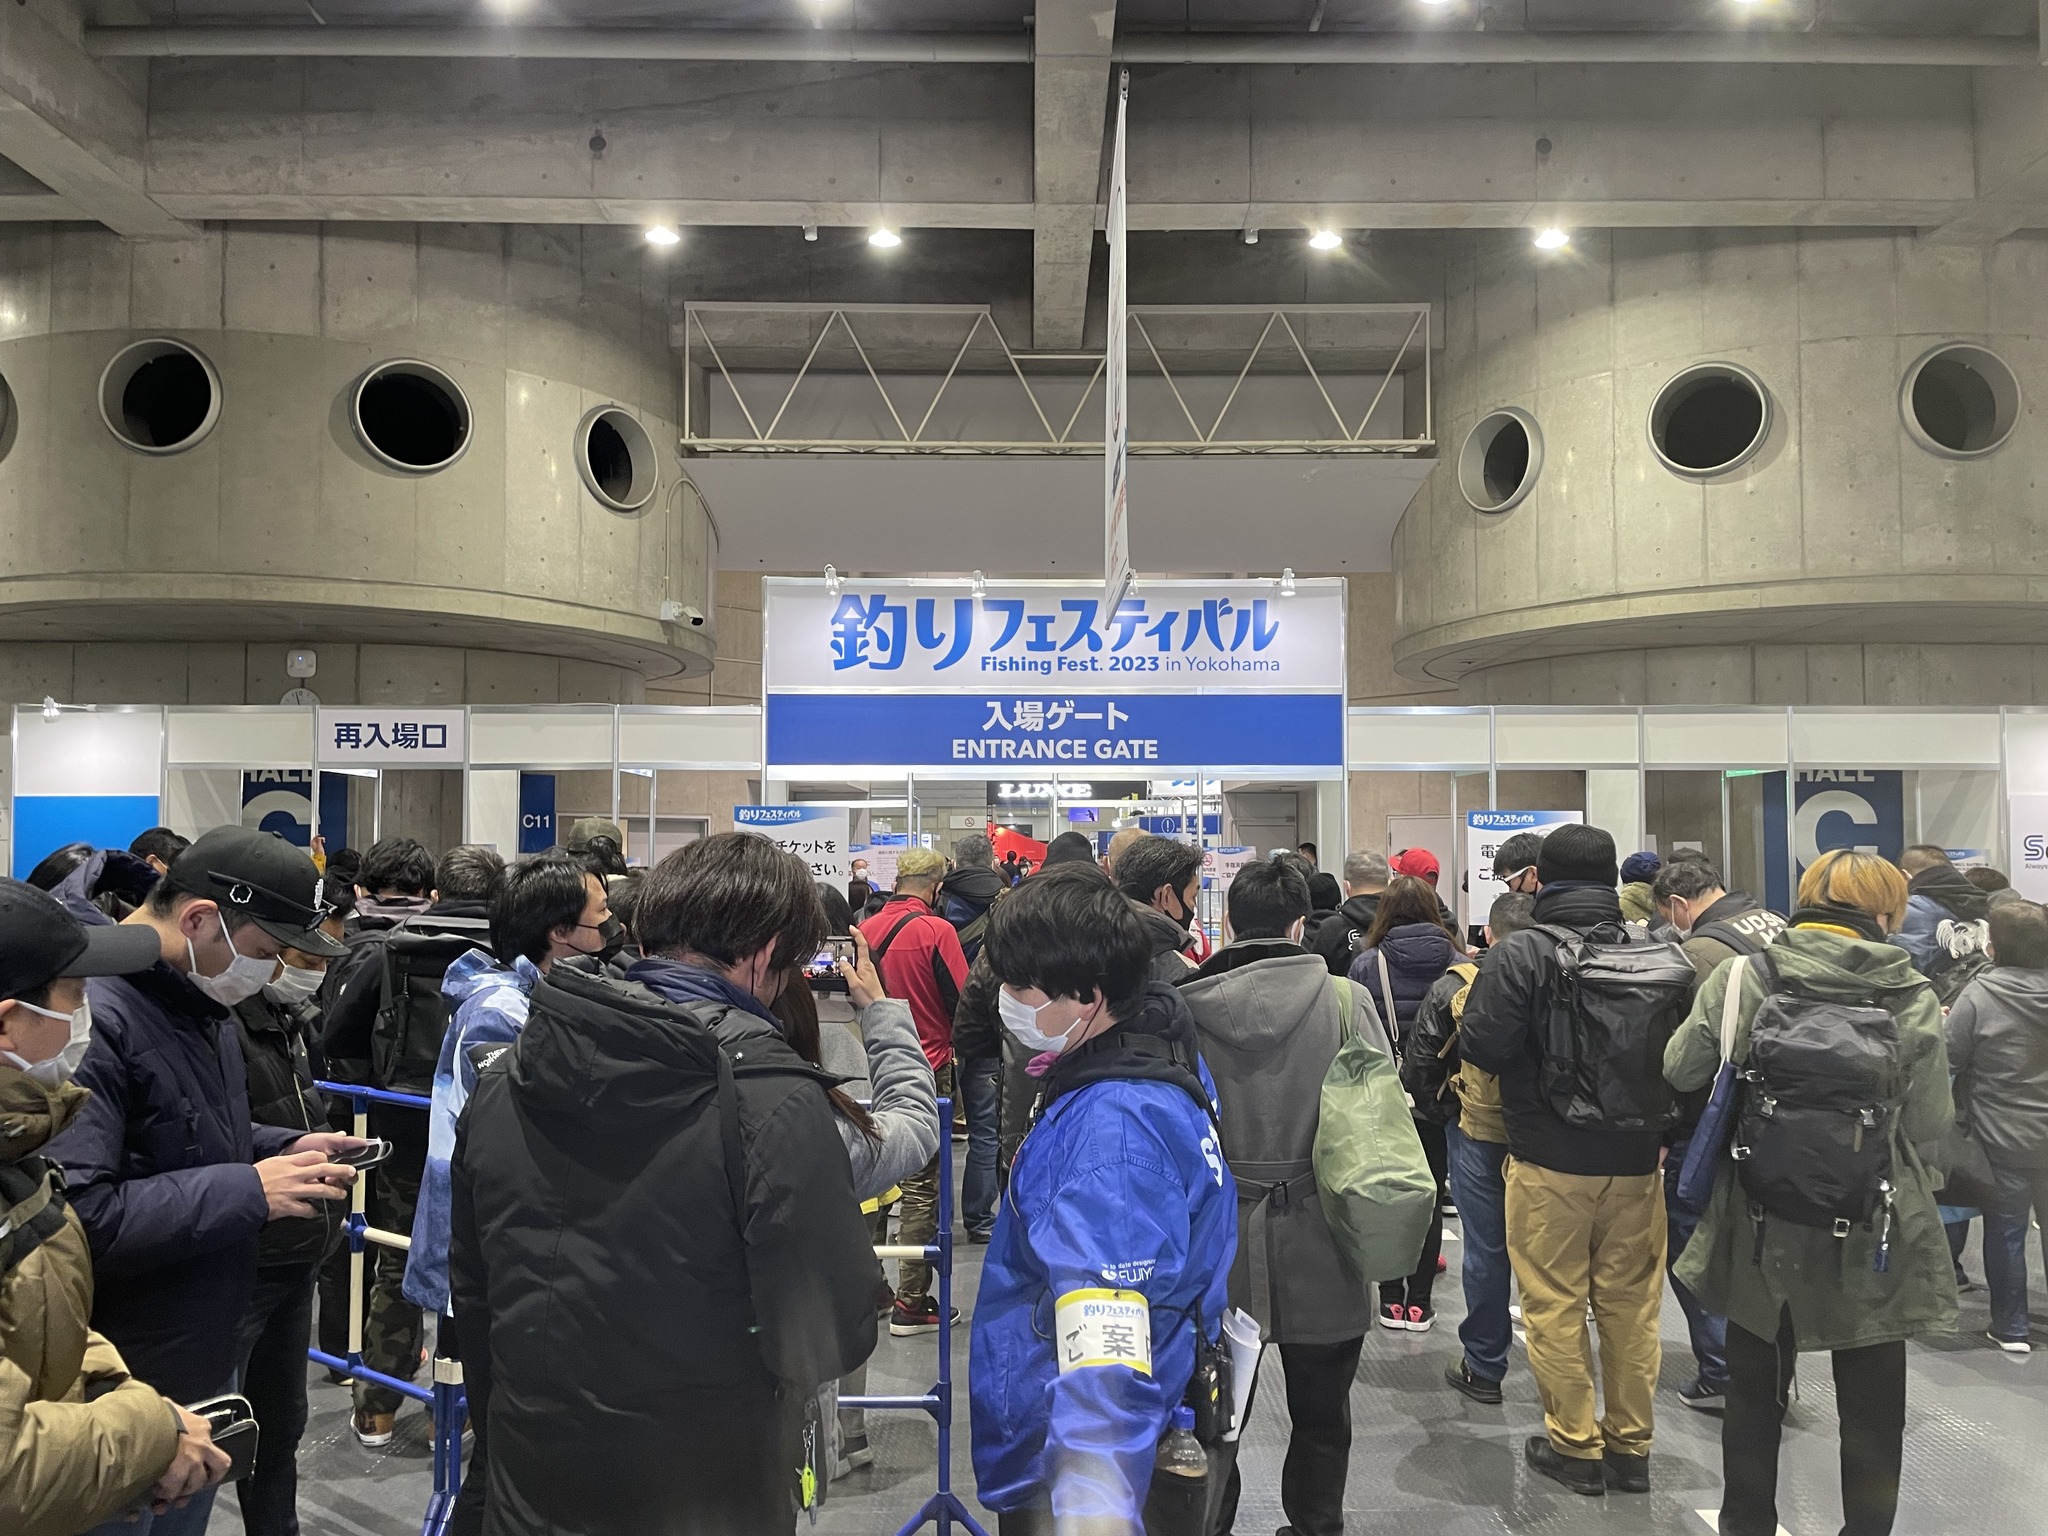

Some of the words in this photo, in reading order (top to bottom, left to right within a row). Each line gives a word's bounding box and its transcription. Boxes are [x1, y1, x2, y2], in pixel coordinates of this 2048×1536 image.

[831, 594, 1280, 672] 釣りフェスティバル
[981, 656, 1052, 675] Fishing
[1057, 656, 1103, 671] Fest.
[1108, 656, 1160, 671] 2023
[1166, 656, 1181, 671] in
[1185, 656, 1280, 671] Yokohama
[982, 700, 1130, 732] 入場ゲート
[334, 723, 447, 748] 再入場口
[952, 739, 1087, 759] ENTRANCE
[1094, 739, 1158, 759] GATE
[523, 814, 550, 829] C11
[739, 809, 801, 821] 釣りフェスティバル
[1472, 813, 1535, 826] 釣りフェスティバル
[1481, 844, 1502, 859] 電
[2023, 834, 2048, 861] S
